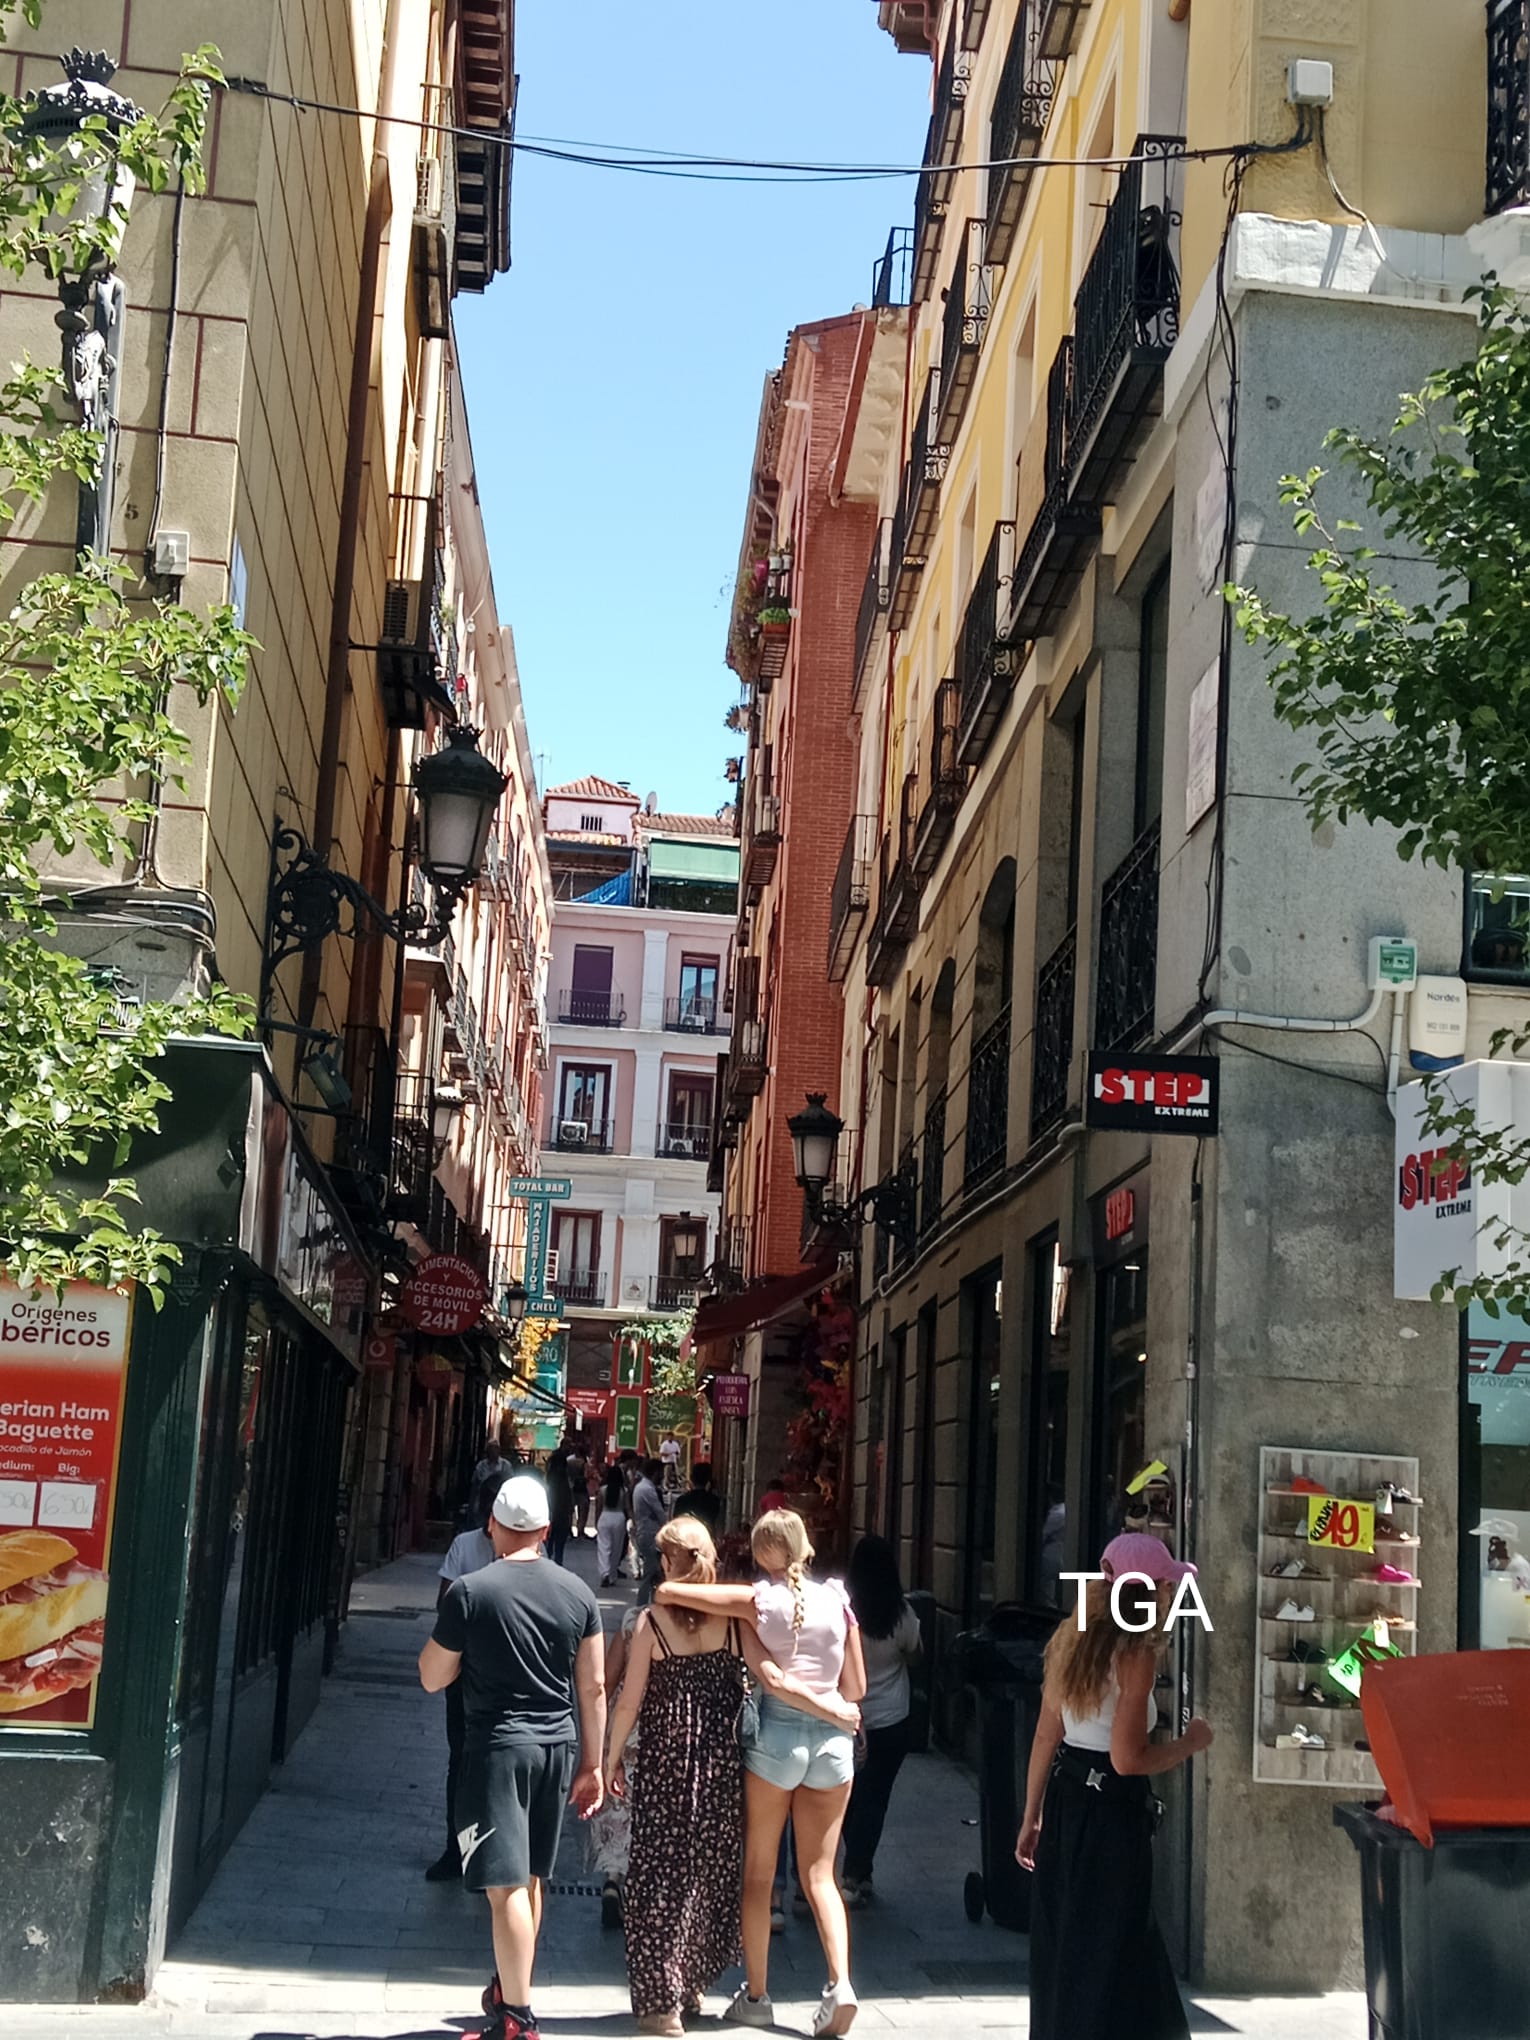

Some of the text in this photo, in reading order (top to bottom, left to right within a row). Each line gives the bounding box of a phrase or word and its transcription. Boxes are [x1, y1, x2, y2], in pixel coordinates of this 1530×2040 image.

[1101, 1068, 1203, 1106] STEP
[1154, 1106, 1209, 1117] EXTREME
[513, 1181, 565, 1193] TOTAL BAR
[1435, 1200, 1472, 1219] EXTREME
[529, 1202, 543, 1292] MAJADERITOS
[443, 1273, 451, 1282] Y
[405, 1280, 484, 1300] ACCESORIOS
[413, 1295, 430, 1306] DE
[531, 1302, 557, 1312] CHELI
[419, 1310, 459, 1331] 24H
[1, 1319, 110, 1347] béricos
[60, 1402, 110, 1421] Ham
[39, 1446, 53, 1455] de
[0, 1460, 35, 1471] dium:
